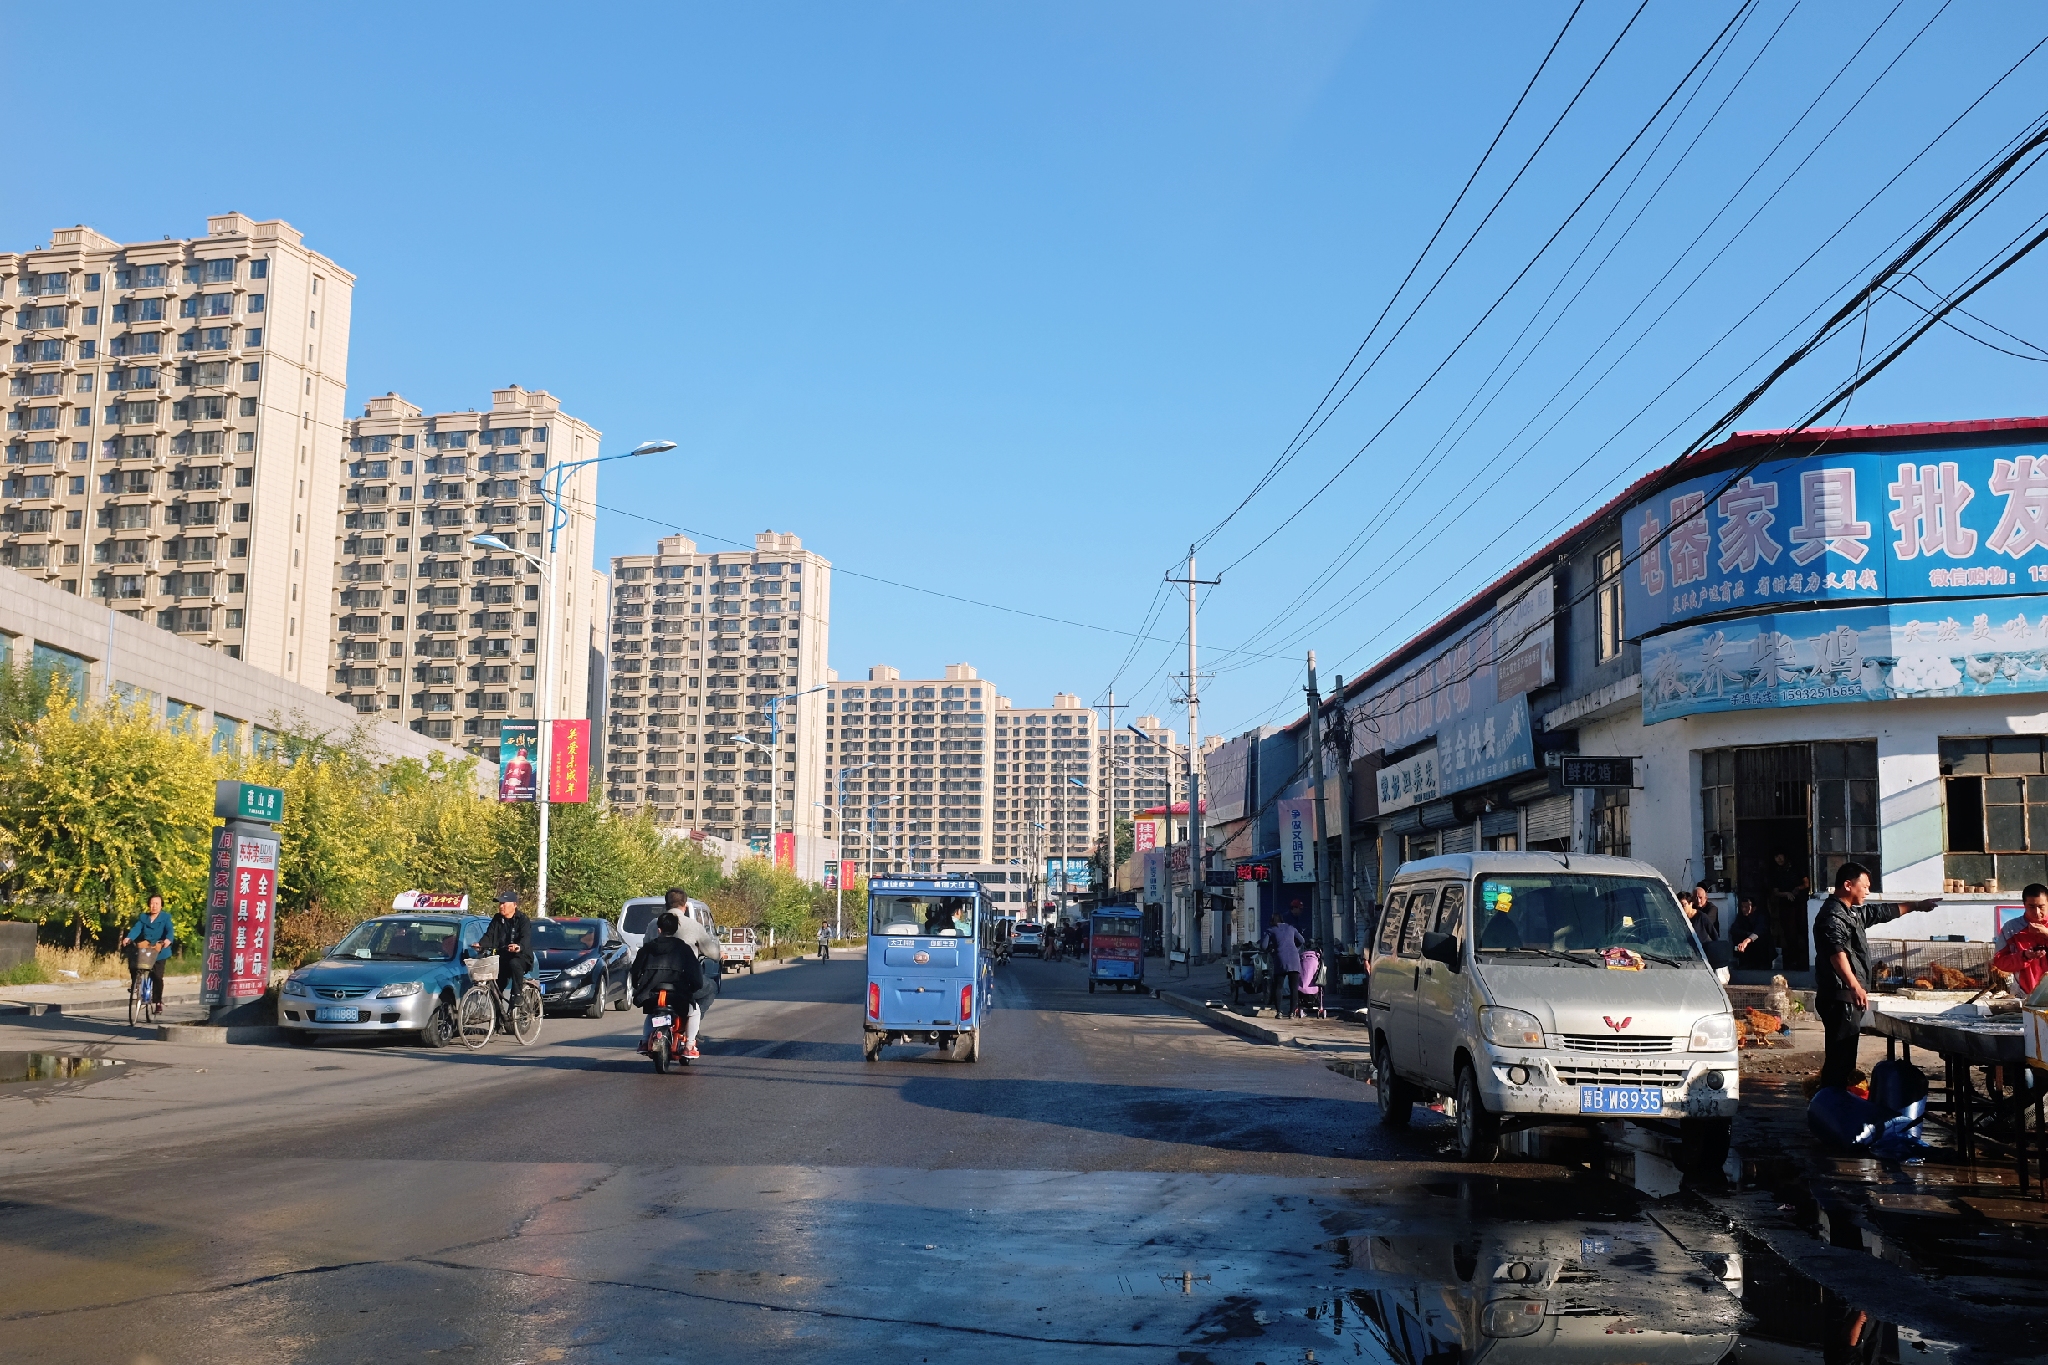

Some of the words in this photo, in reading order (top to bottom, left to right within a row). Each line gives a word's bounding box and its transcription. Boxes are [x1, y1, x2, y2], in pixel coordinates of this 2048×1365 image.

[1639, 454, 2048, 596] 电器家具批发
[1755, 568, 1878, 597] 省时省力又省钱
[1652, 626, 1863, 699] 散养柴鸡
[565, 728, 579, 796] 关爱未成年
[1441, 717, 1496, 775] 老金快餐
[247, 790, 275, 808] 燕山路
[1237, 865, 1269, 880] 超市
[206, 914, 226, 991] 高端低价
[233, 872, 251, 976] 家具基地
[252, 873, 269, 977] 全球名品
